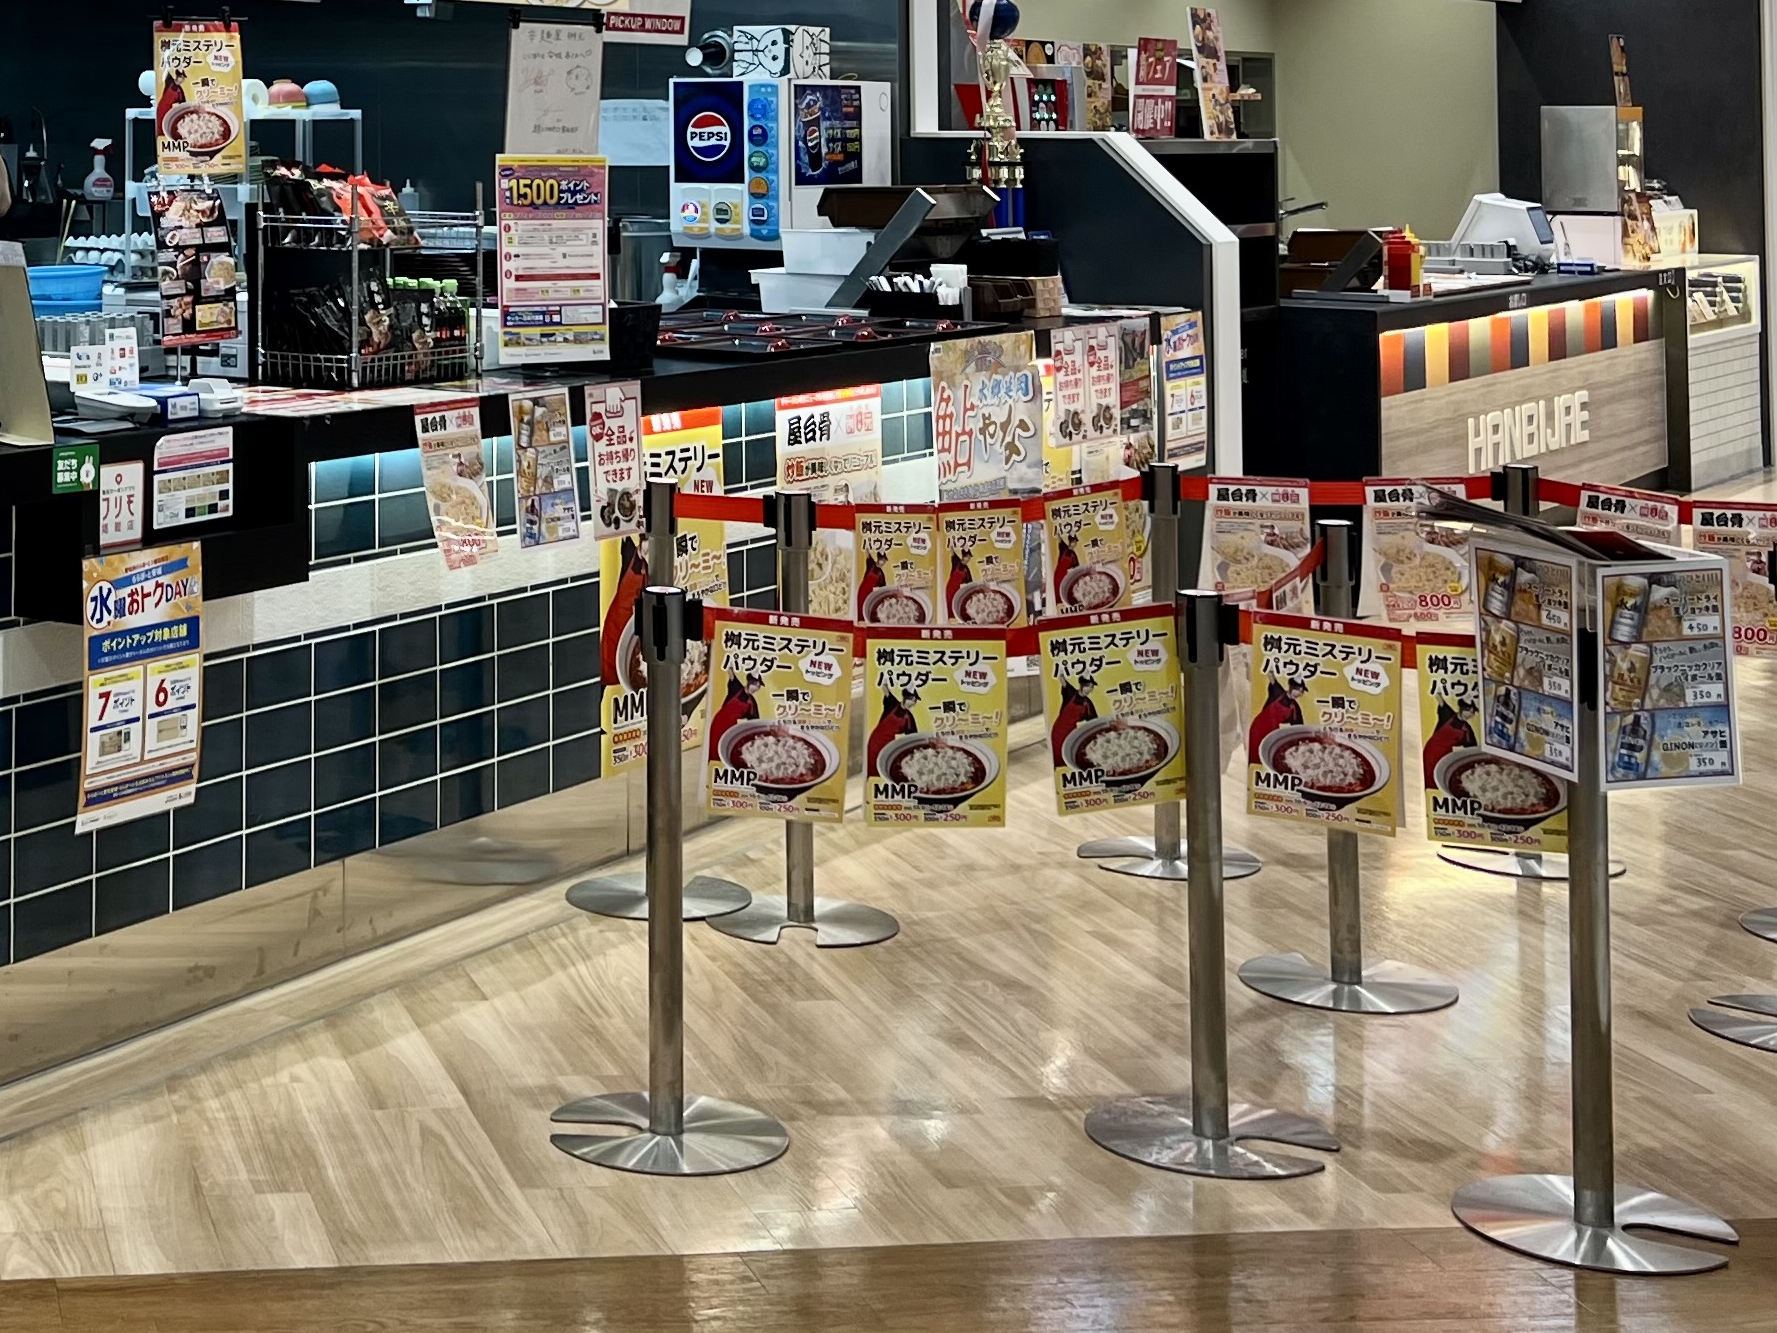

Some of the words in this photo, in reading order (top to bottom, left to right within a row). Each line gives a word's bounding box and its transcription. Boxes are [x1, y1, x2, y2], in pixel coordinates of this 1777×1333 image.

[609, 16, 643, 30] PICKUP
[644, 17, 682, 32] WINDOW
[690, 130, 728, 143] PEPSI
[161, 140, 190, 153] MMP
[604, 426, 628, 447] 全品
[787, 411, 832, 447] 屋台骨
[1468, 390, 1590, 474] HANBIJAE
[597, 447, 636, 467] お持ち帰り
[602, 467, 633, 482] できます
[694, 479, 714, 494] NEW
[1050, 499, 1119, 520] 桝元ミステリー
[861, 519, 933, 536] 桝元ミステリー
[944, 515, 1017, 533] 桝元ミステリー
[1053, 518, 1093, 536] パウダー
[861, 536, 904, 552] パウダー
[946, 533, 988, 550] パウダー
[1417, 593, 1462, 611] 800円
[768, 614, 801, 628] 新発売
[1089, 611, 1122, 625] 新発売
[1310, 619, 1345, 634] 新発売
[920, 628, 954, 640] 新発売
[1686, 621, 1709, 634] 450
[101, 623, 189, 653] ポイントアップ対象店舗
[722, 630, 846, 656] 桝元ミステリー
[1049, 628, 1169, 658] 桝元ミステリー
[1136, 648, 1160, 659] NEW
[1262, 633, 1393, 665] 桝元ミステリー
[722, 655, 793, 674] パウダー
[809, 658, 834, 672] NEW
[875, 647, 1000, 669] 桝元ミステリー
[964, 669, 989, 681] NEW
[1052, 656, 1123, 679] パウダー
[1262, 657, 1339, 680] パウダー
[1354, 666, 1382, 682] NEW
[876, 669, 948, 689] パウダー
[771, 688, 812, 704] 一瞬で
[1105, 681, 1143, 697] 一瞬で
[1692, 690, 1712, 701] 350
[97, 689, 113, 722] 7
[154, 677, 169, 708] 6
[928, 700, 967, 715] 一瞬で
[1315, 697, 1358, 712] 一瞬で
[1701, 729, 1727, 739] アサヒ
[1696, 757, 1715, 768] 350
[713, 767, 757, 786] MMP
[1061, 767, 1106, 789] MMP
[1253, 771, 1304, 793] MMP
[873, 783, 920, 800] MMP
[1431, 795, 1483, 818] MMP
